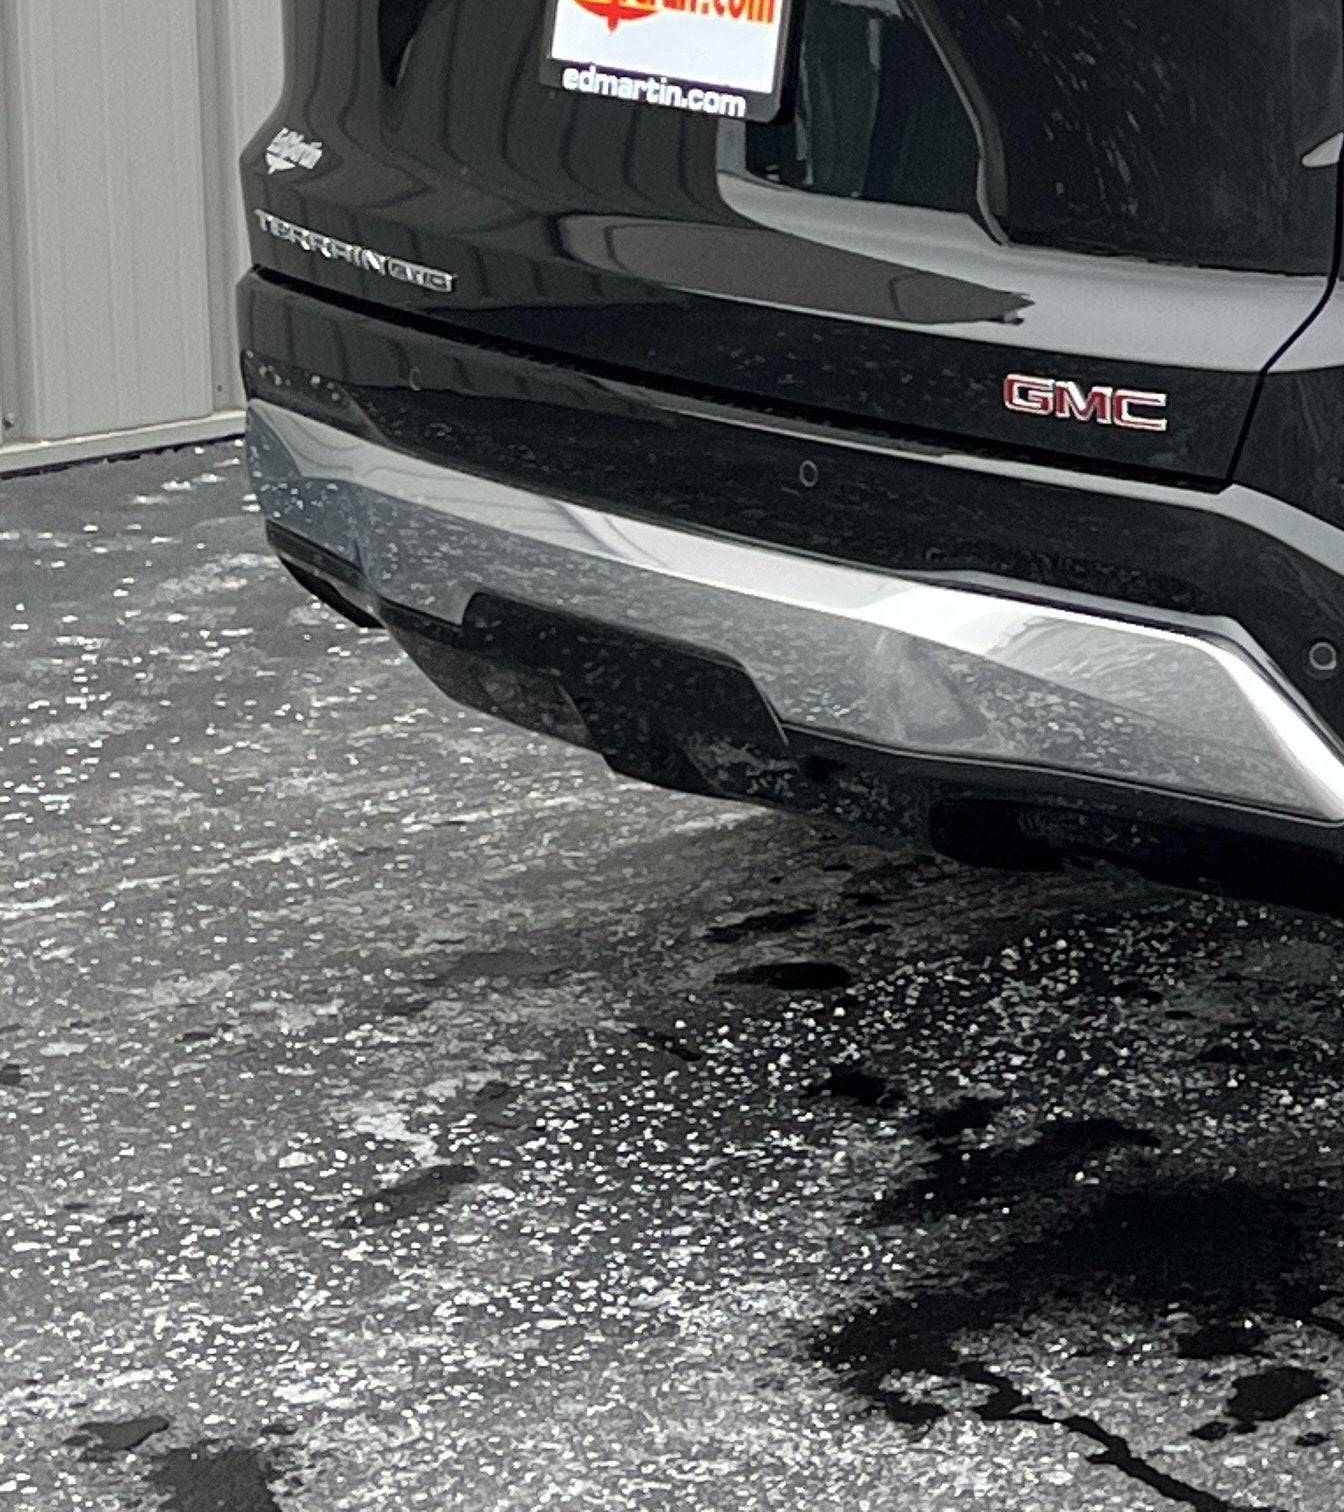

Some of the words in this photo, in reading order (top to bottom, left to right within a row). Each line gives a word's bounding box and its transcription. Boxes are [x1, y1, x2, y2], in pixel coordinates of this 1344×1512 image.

[562, 64, 747, 118] edmartin.com
[254, 208, 386, 277] TERRAIN
[1003, 373, 1168, 432] GMC
